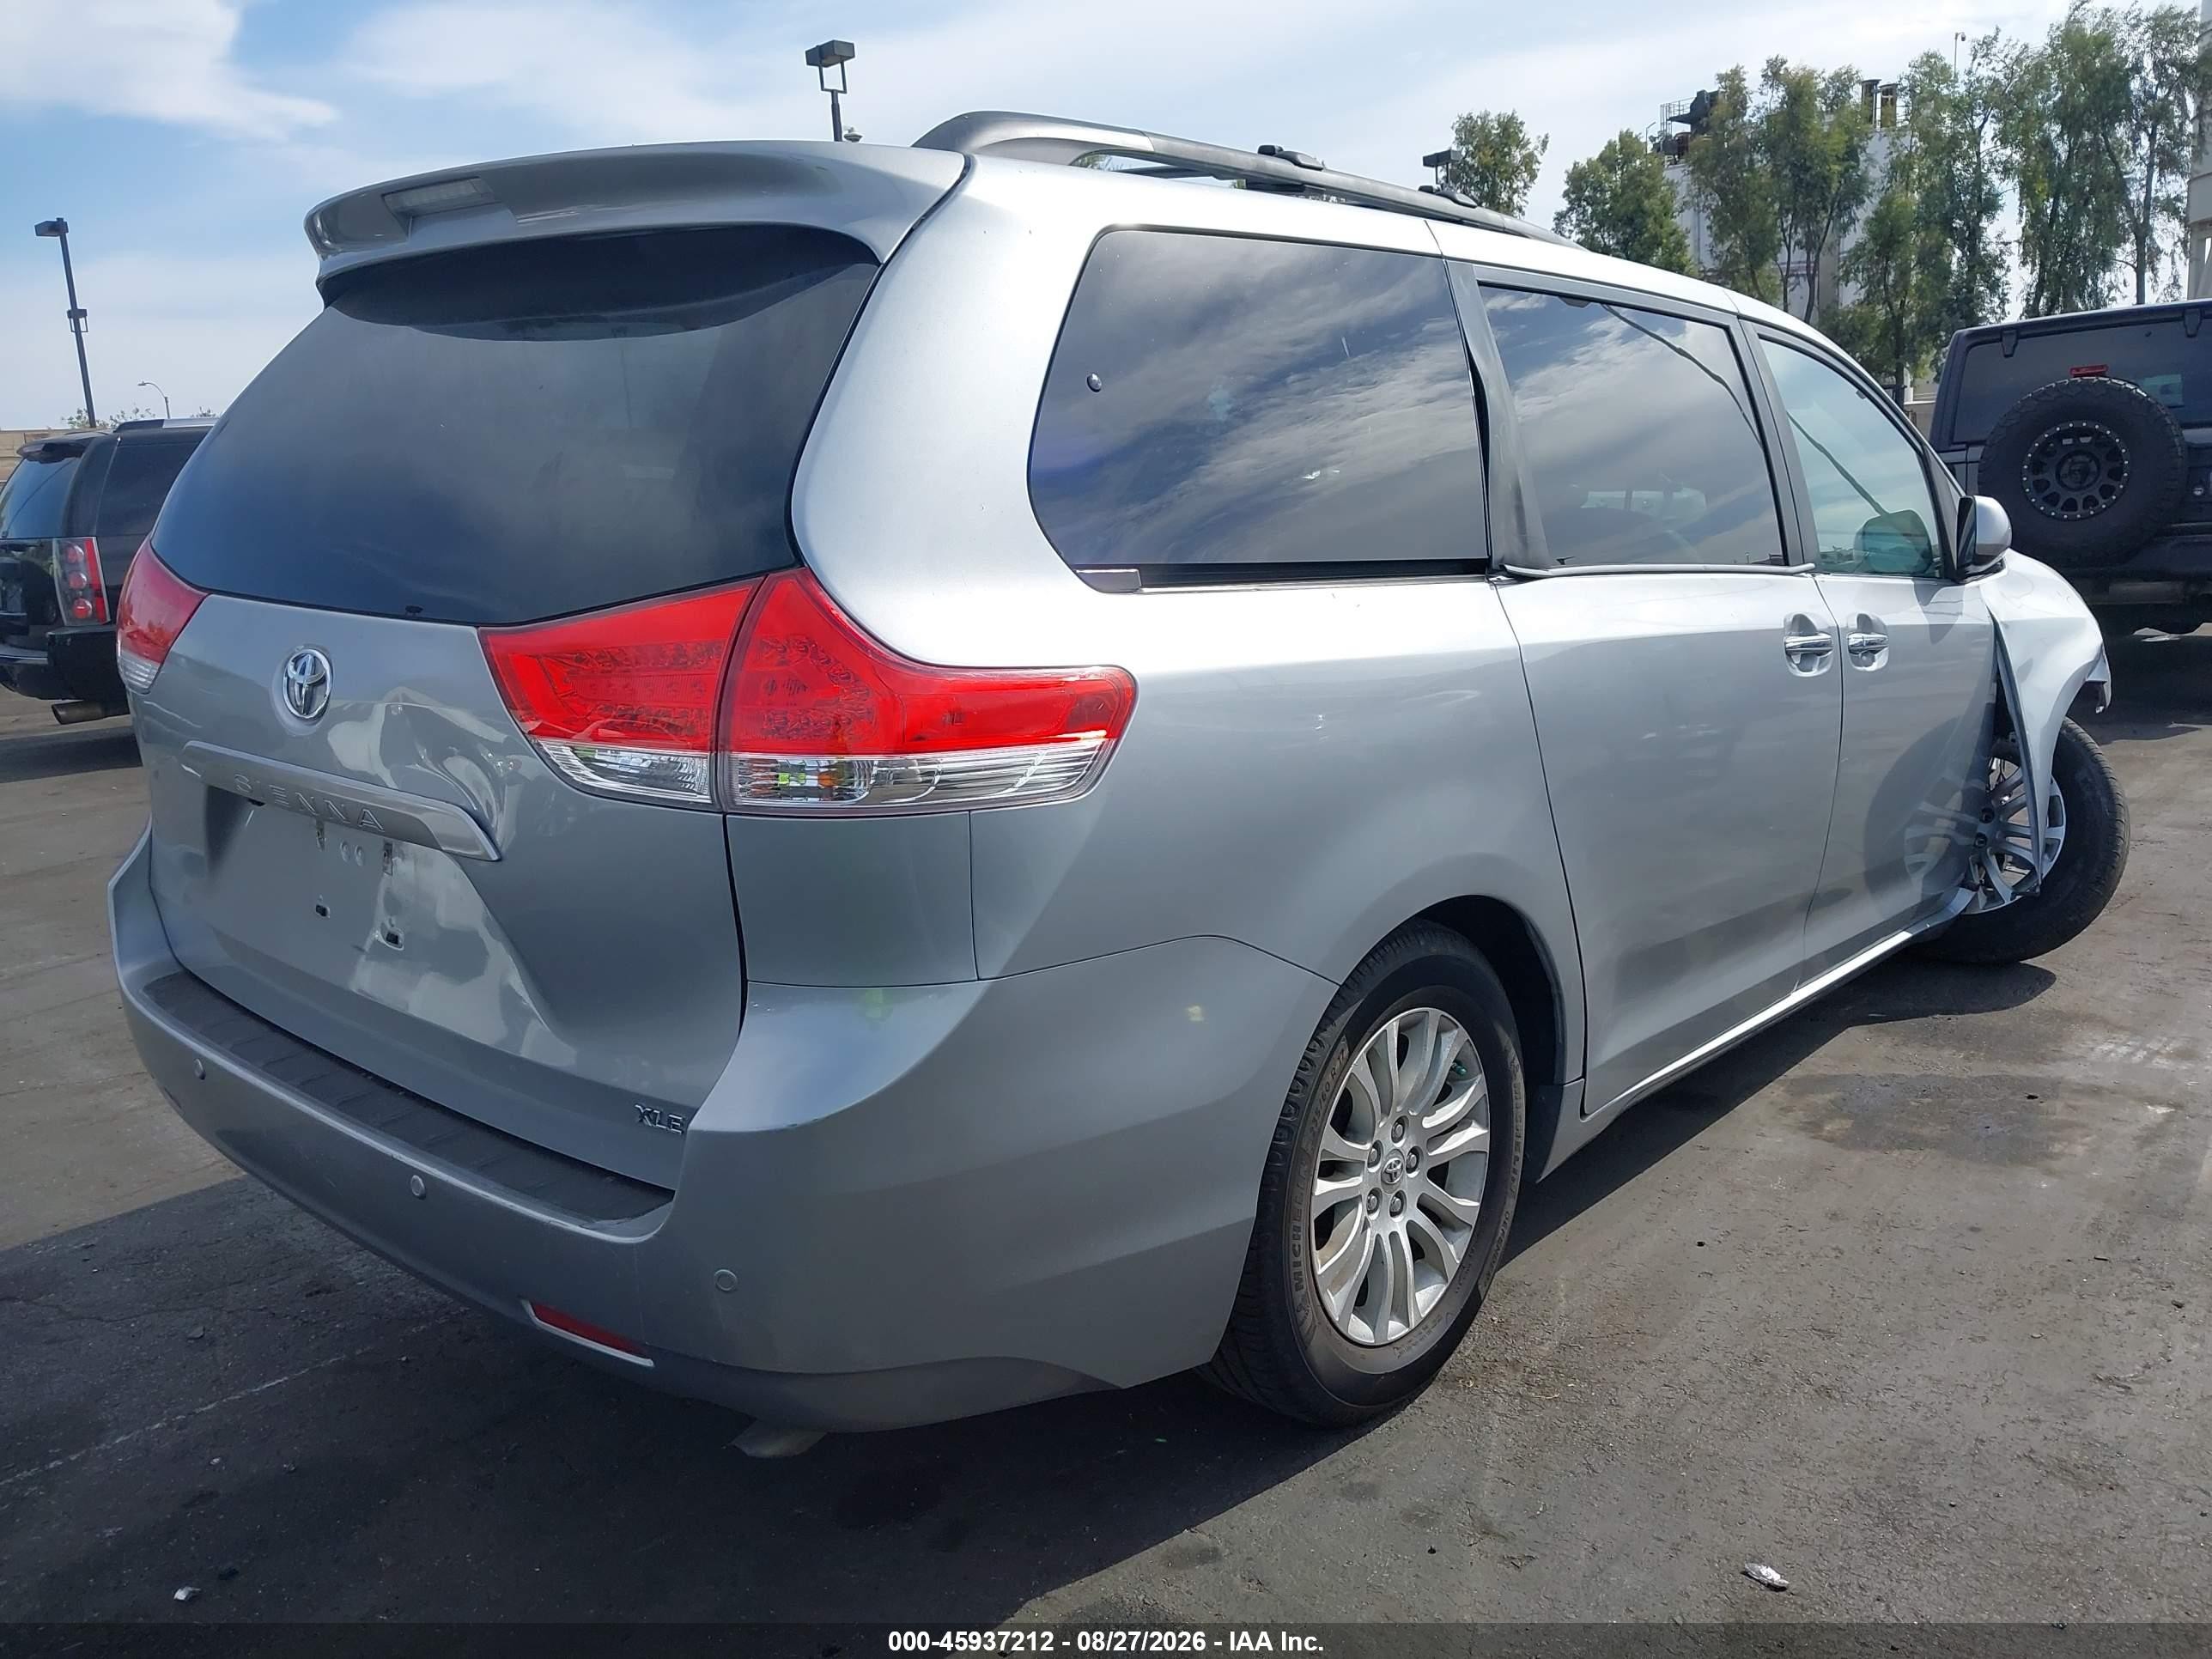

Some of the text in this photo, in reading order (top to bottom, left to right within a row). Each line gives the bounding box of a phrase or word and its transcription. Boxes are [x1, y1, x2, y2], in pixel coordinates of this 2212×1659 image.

[234, 774, 386, 832] SENNA
[635, 1103, 684, 1134] XLE
[1291, 1164, 1308, 1292] MICHELIN
